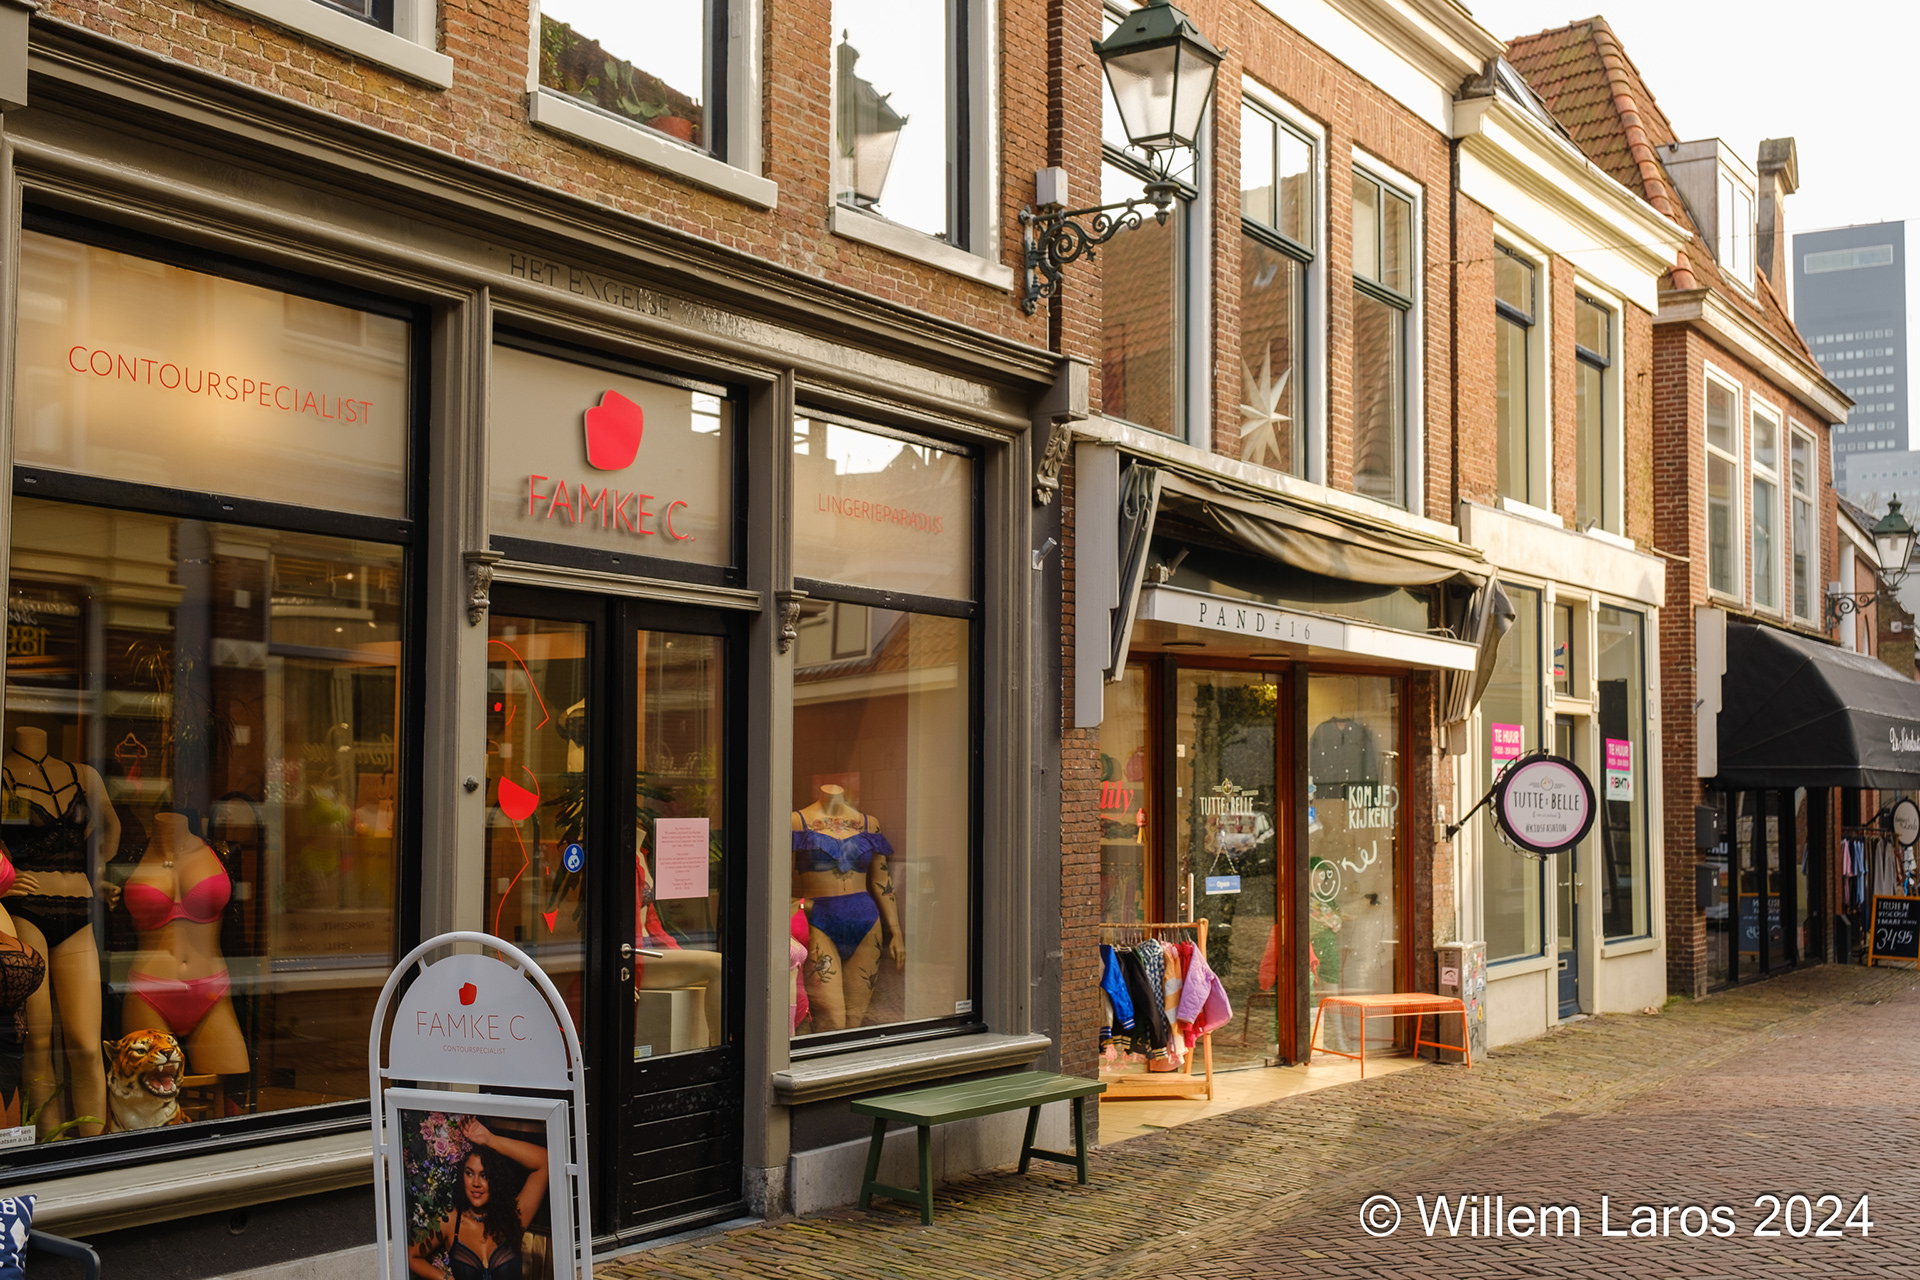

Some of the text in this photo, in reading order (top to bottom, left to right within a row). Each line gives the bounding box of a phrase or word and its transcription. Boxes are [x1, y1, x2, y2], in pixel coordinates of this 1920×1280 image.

[509, 253, 559, 287] HET
[69, 346, 373, 424] CONTOURSPECIALIST
[528, 474, 697, 541] FAMKE C.
[1494, 729, 1519, 744] TE HUUR
[1608, 743, 1628, 757] TE HUUR
[1199, 796, 1226, 816] TUTTE
[1230, 796, 1255, 816] BELLE
[1349, 784, 1391, 809] KOM JE
[1513, 791, 1543, 809] TUTTE
[1551, 793, 1580, 811] BELLE
[416, 1011, 532, 1041] FAMKE C.
[443, 1045, 506, 1055] CONTOURSPECIALIST
